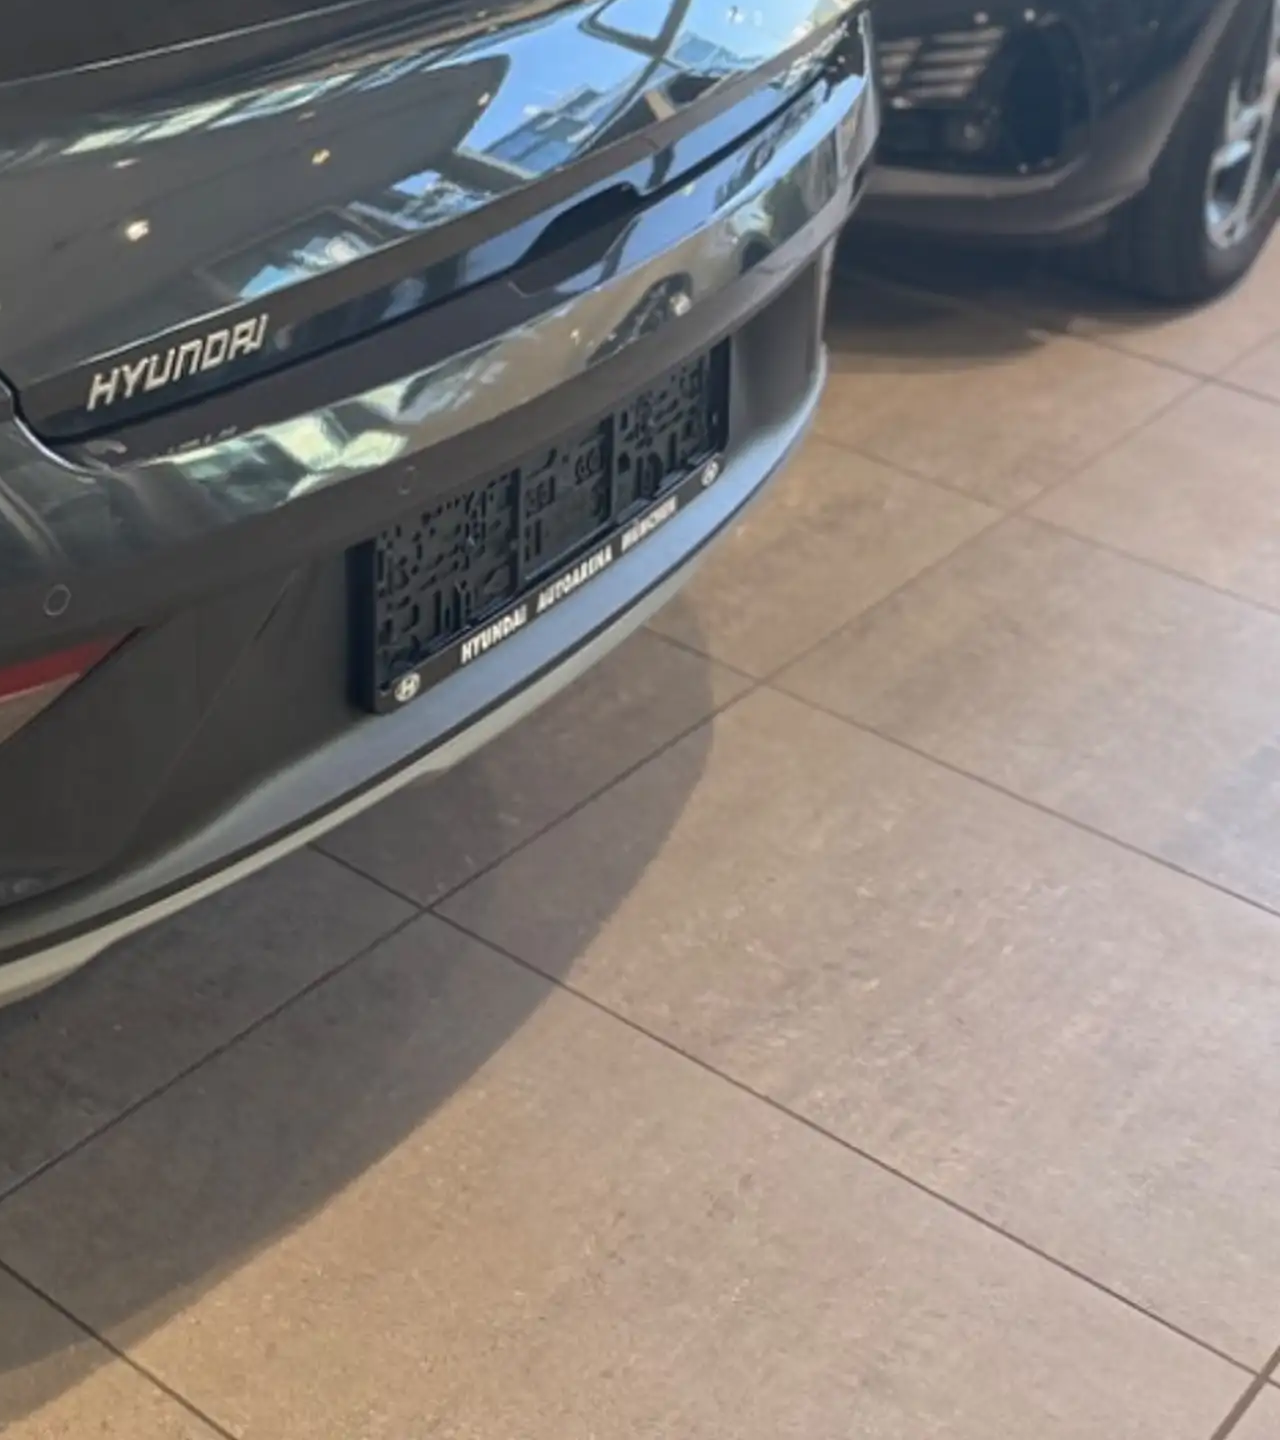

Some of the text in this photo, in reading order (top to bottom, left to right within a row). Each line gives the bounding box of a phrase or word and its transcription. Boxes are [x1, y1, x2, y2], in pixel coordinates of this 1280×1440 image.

[86, 313, 270, 411] HYUNDAI
[461, 603, 528, 664] HYUNDAI
[536, 545, 613, 612] AUTOARENA
